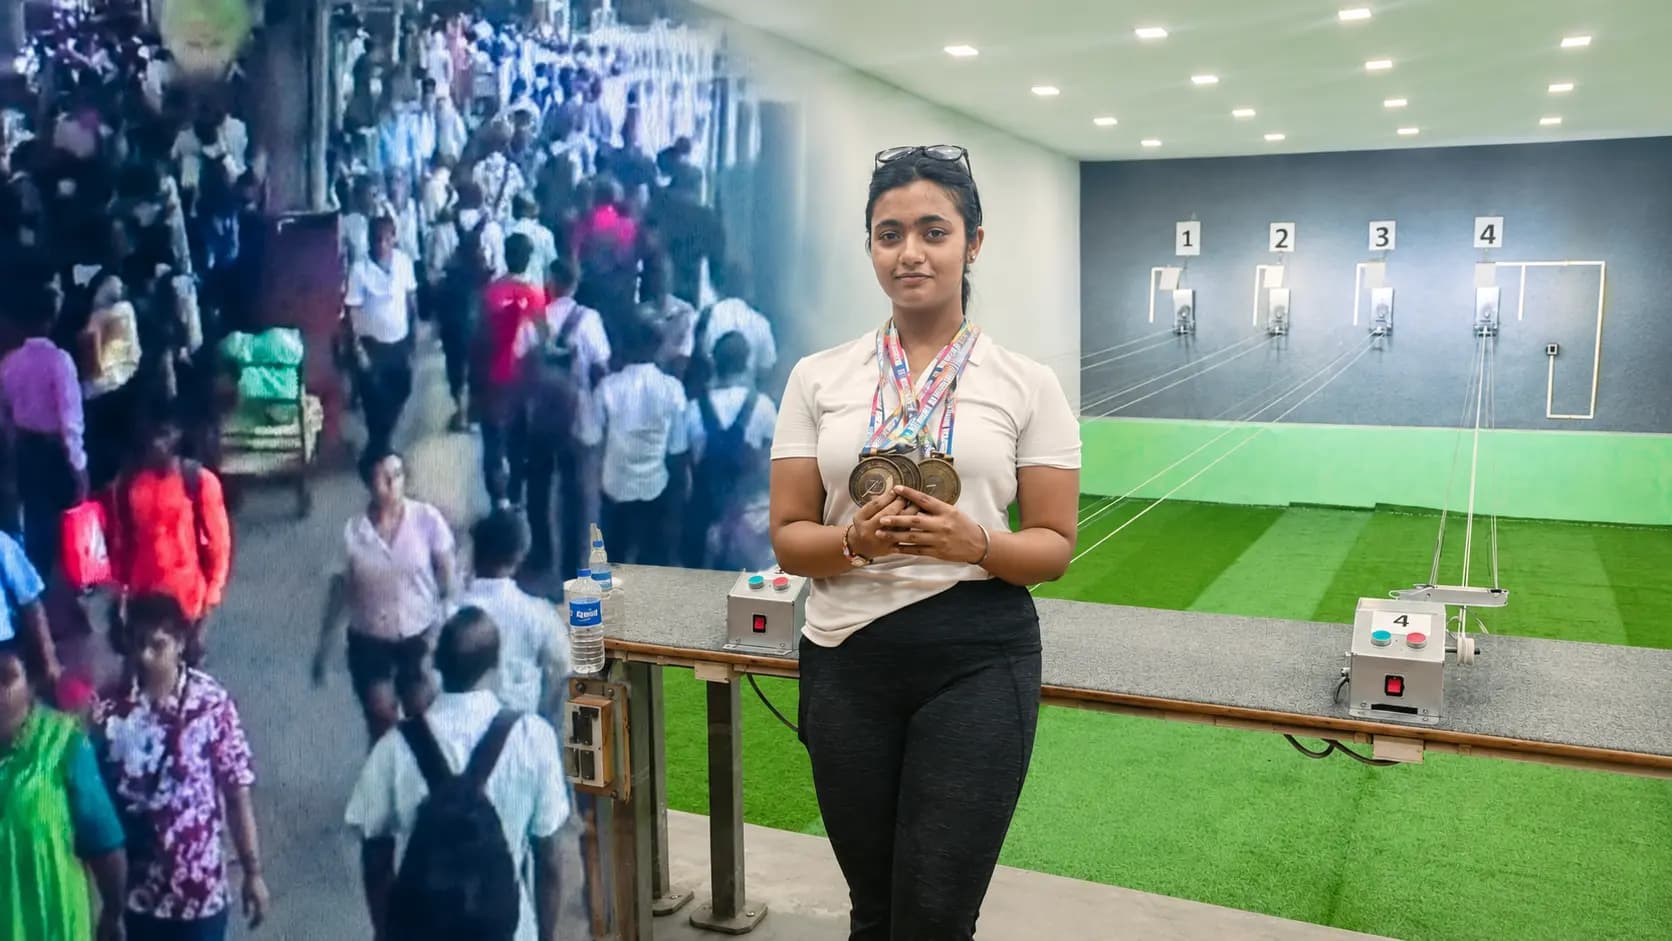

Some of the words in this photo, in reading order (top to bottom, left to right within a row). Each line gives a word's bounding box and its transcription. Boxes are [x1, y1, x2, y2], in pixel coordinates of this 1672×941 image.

[1182, 230, 1193, 247] 1
[1275, 229, 1289, 248] 2
[1375, 227, 1389, 247] 3
[1480, 224, 1496, 245] 4
[1394, 615, 1409, 627] 4
